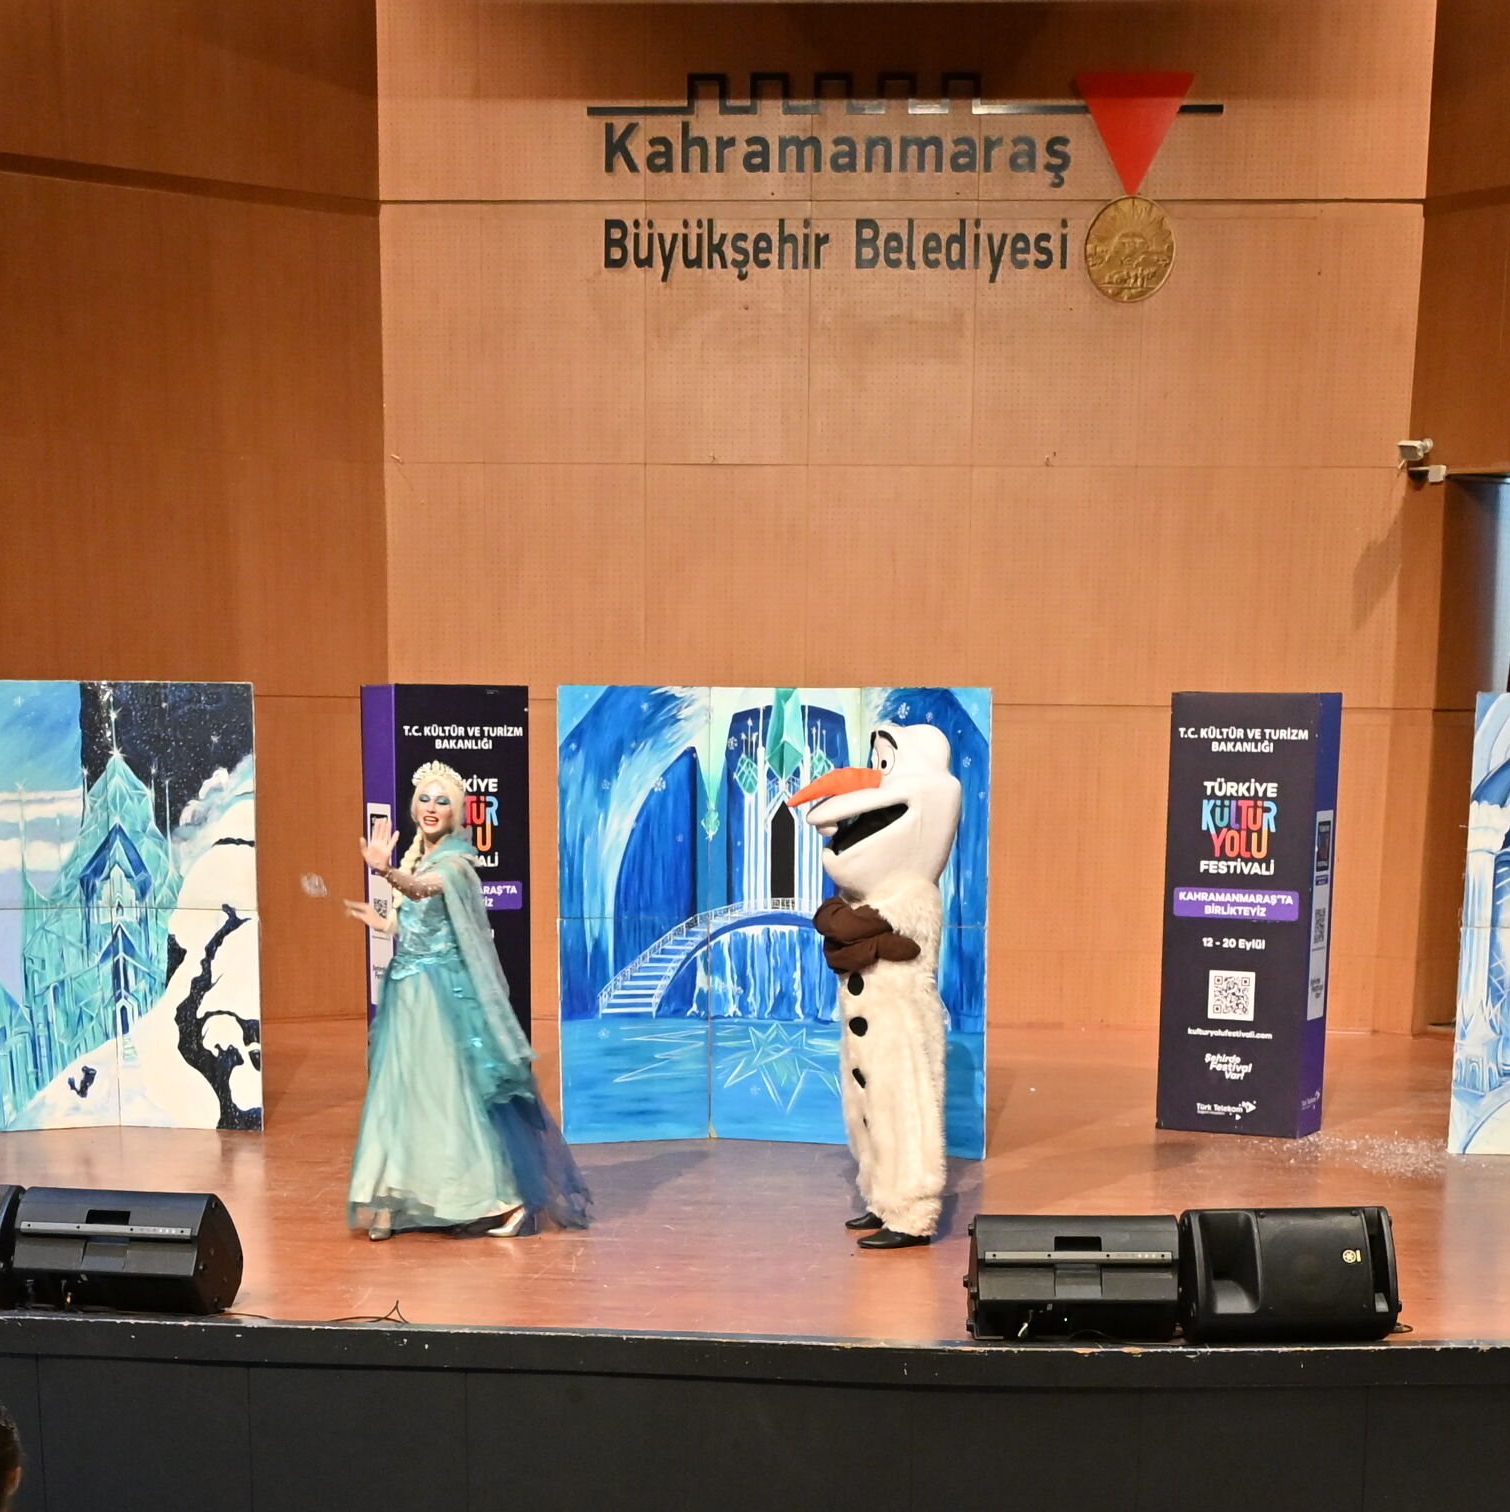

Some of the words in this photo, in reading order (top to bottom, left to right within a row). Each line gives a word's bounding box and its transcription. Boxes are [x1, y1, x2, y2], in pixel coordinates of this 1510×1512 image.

[603, 121, 1072, 189] Kahramanmaraş
[603, 218, 831, 283] Büyükşehir
[854, 218, 1069, 284] Belediyesi
[403, 725, 422, 737] T.C.
[424, 724, 465, 737] KÜLTÜR
[467, 726, 481, 737] VE
[482, 725, 523, 737] TURİZM
[1179, 727, 1198, 739] T.C.
[1200, 726, 1244, 739] KÜLTÜR
[1246, 728, 1262, 739] VE
[1264, 727, 1309, 740] TURİZM
[435, 738, 493, 750] BAKANLIĞI
[1211, 740, 1274, 753] BAKANLIĞI
[463, 774, 498, 793] KİYE
[1203, 777, 1278, 798] TÜRKİYE
[1201, 799, 1278, 834] KÜLTÜR
[1211, 828, 1268, 859] YOLU
[1199, 858, 1275, 875] FESTİVALİ
[1178, 891, 1294, 906] KAHRAMANMARAŞ'TA
[1204, 903, 1267, 917] BİRLİKTEYİZ
[1222, 937, 1237, 948] 20
[1238, 938, 1266, 951] Eylül
[1209, 1062, 1253, 1073] Festival
[1196, 1102, 1212, 1111] Türk
[1213, 1104, 1243, 1113] Telekom
